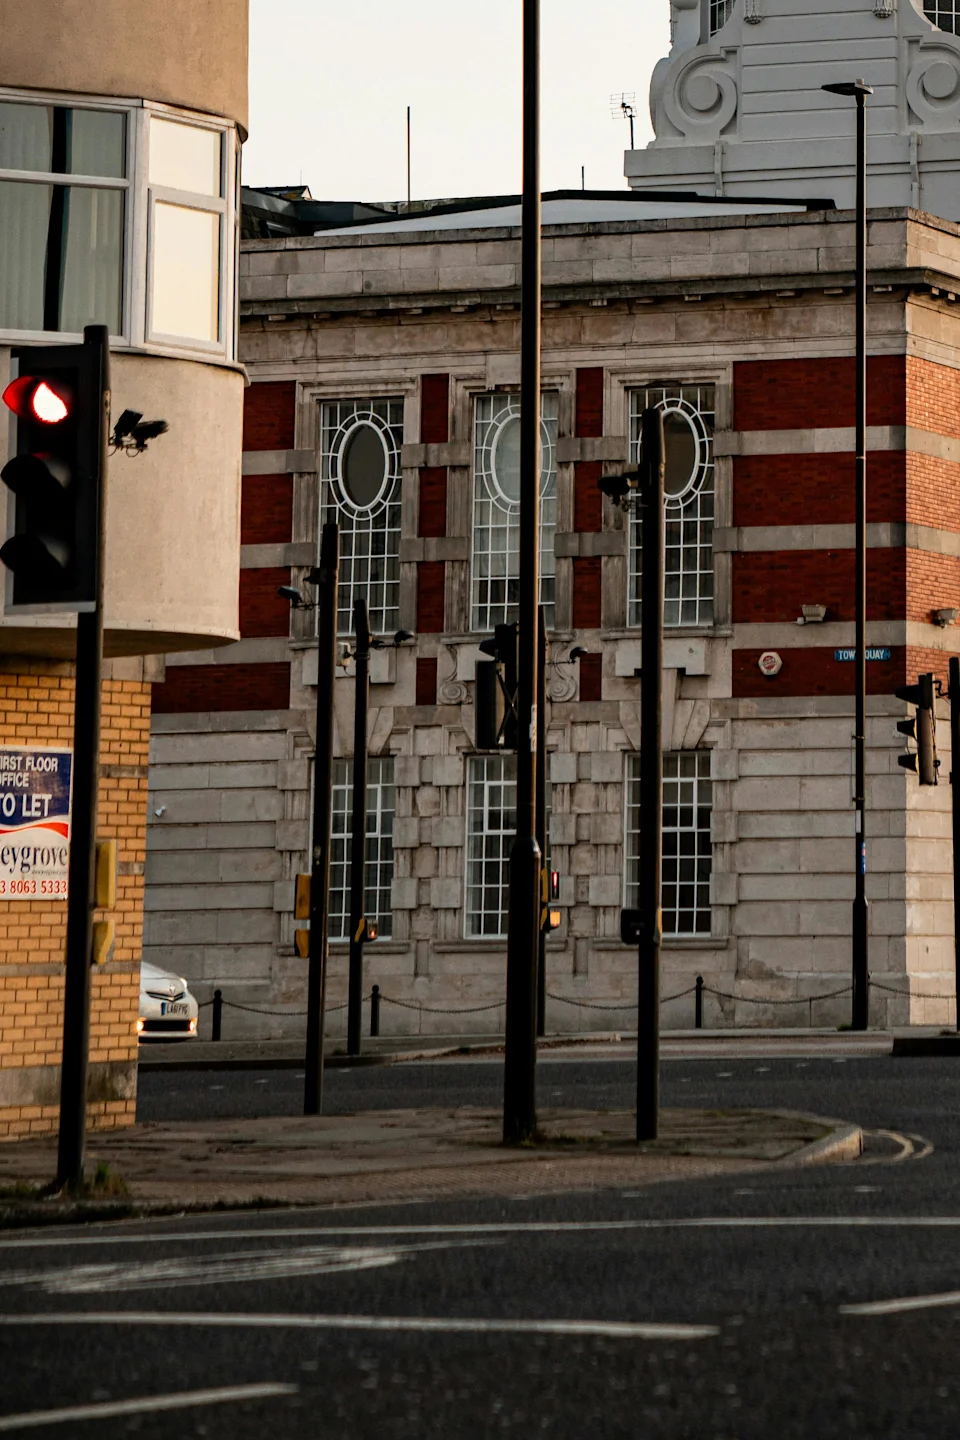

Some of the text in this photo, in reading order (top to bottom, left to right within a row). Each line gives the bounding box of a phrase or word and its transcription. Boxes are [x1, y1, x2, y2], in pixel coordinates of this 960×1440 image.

[838, 650, 884, 660] TOW QUAY
[0, 756, 58, 772] IRST FLOOR
[0, 772, 29, 787] FFICE
[22, 793, 52, 817] LET
[1, 846, 68, 873] eygrove
[10, 880, 36, 894] 8063
[41, 880, 67, 894] 5333
